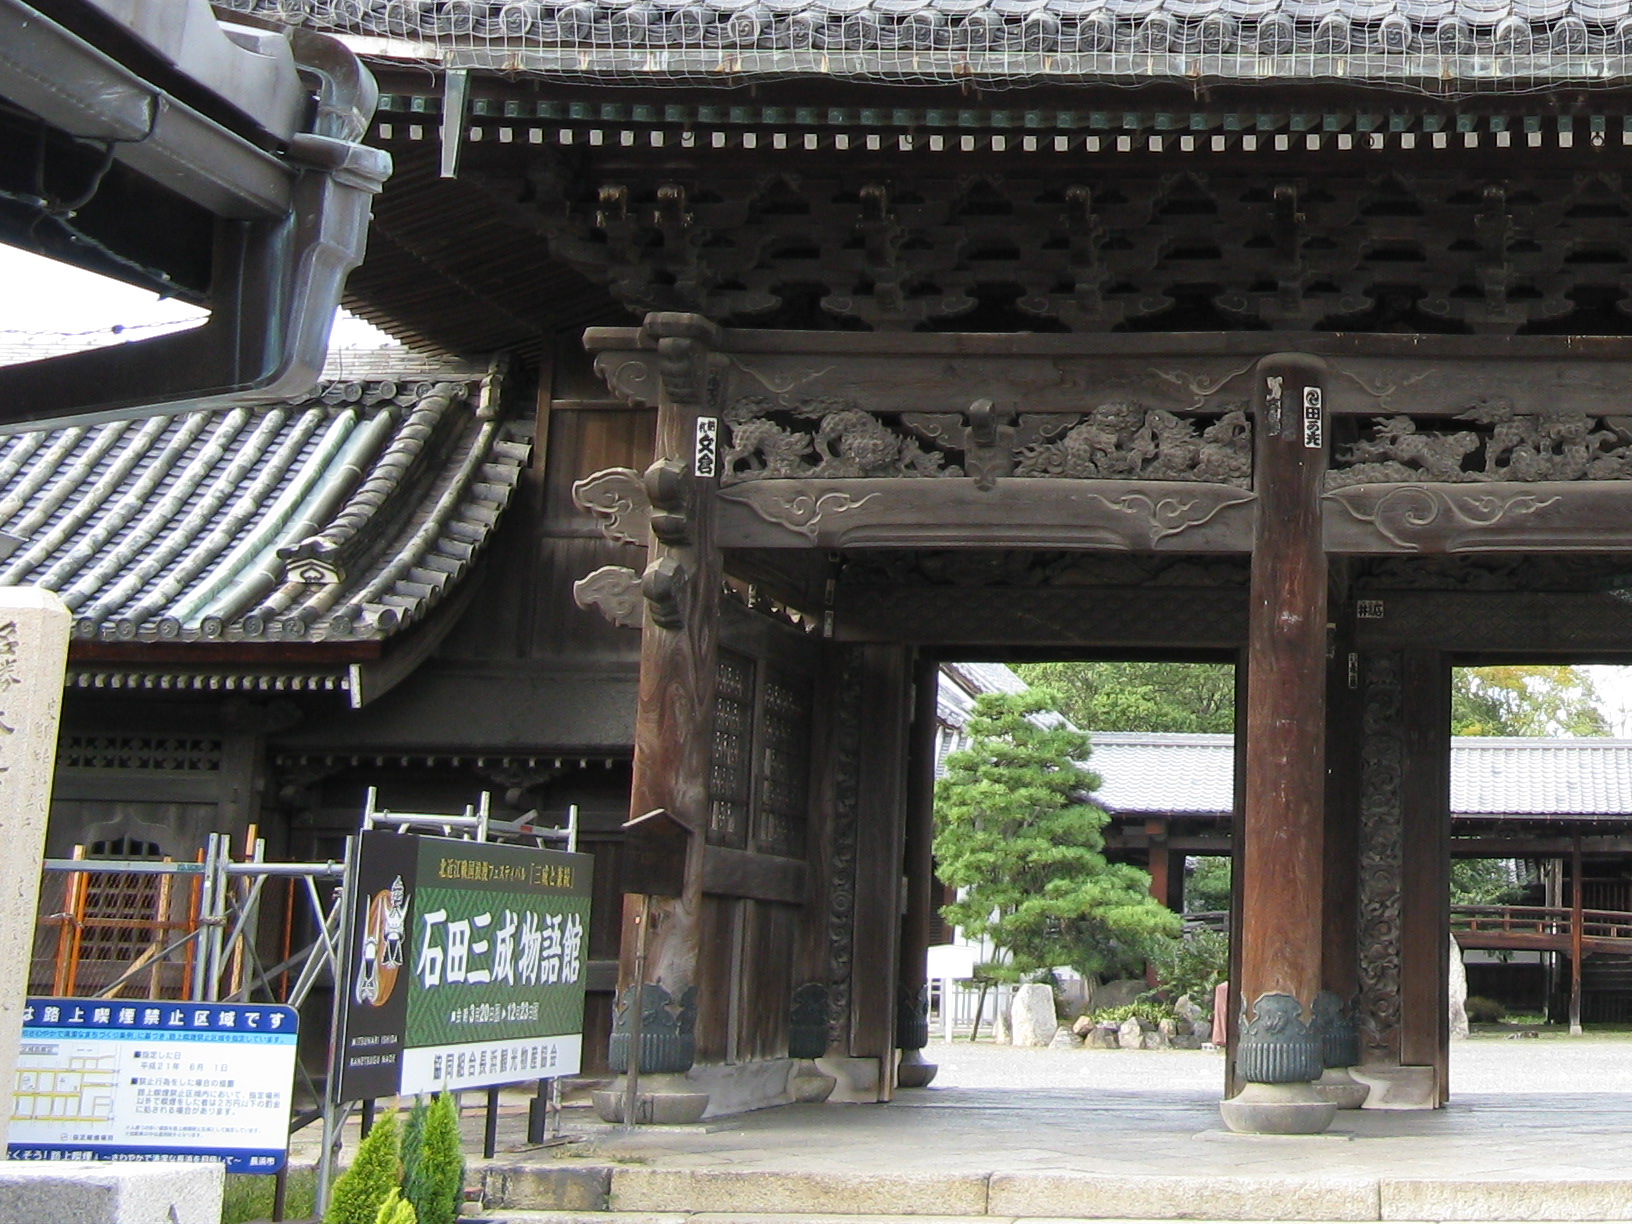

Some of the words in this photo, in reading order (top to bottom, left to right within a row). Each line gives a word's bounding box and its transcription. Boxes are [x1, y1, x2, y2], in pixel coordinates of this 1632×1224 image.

[416, 908, 584, 989] 石田三成物語館
